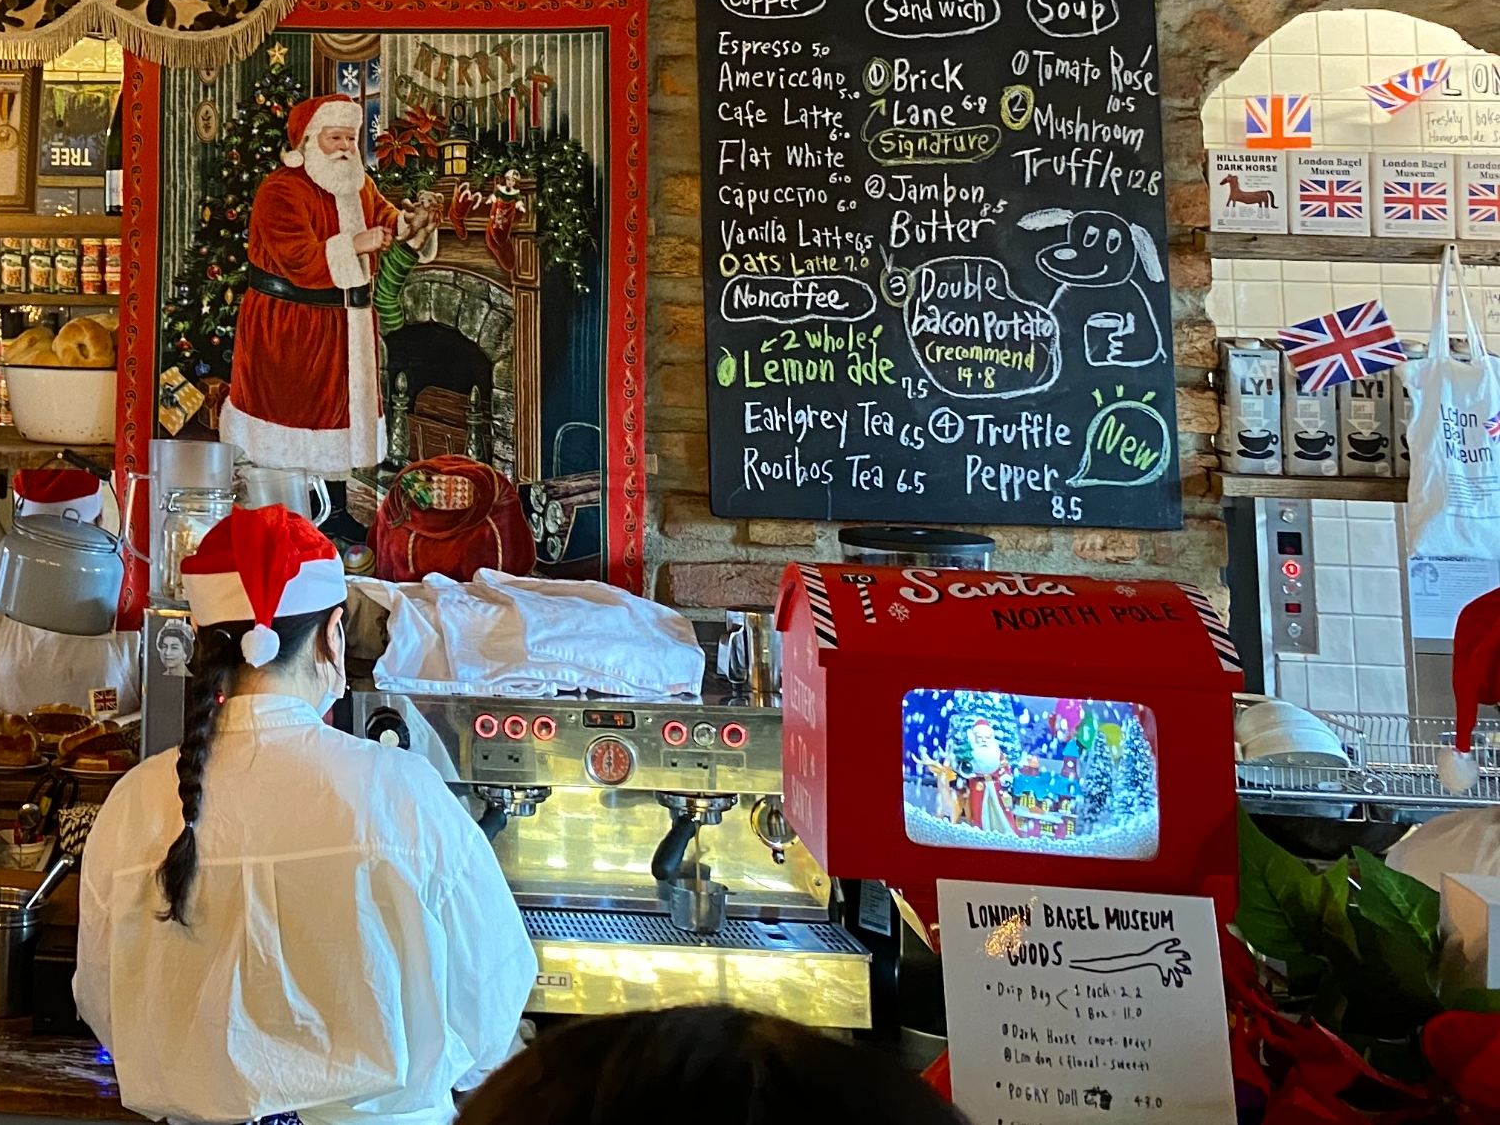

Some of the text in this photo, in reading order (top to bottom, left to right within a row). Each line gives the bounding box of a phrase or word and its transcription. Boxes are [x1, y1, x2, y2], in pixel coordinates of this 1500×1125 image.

[414, 39, 516, 87] MERRY
[718, 31, 801, 65] Espresso
[893, 58, 964, 92] Brick
[1033, 50, 1100, 86] Tomato
[784, 98, 843, 129] Latte
[893, 100, 956, 127] Lane
[1033, 103, 1144, 152] Mushroom
[50, 147, 92, 166] TREE
[718, 138, 772, 175] Flat
[879, 131, 990, 158] Signature
[1216, 154, 1278, 163] HILLSBURRY
[1010, 147, 1122, 196] Truffle
[1217, 164, 1243, 172] DARK
[1298, 157, 1362, 168] London Bagel
[1311, 167, 1350, 176] Museum
[1383, 159, 1447, 170] London Bagel
[1395, 169, 1435, 178] Museum
[888, 173, 985, 207] Jambon
[721, 216, 786, 252] Vanilla
[799, 219, 853, 249] Latte
[890, 208, 996, 249] Butter
[719, 252, 781, 277] Oats
[790, 252, 841, 276] Latte
[921, 262, 1006, 303] Double
[912, 297, 978, 337] bacon
[744, 350, 834, 388] Lemon
[745, 397, 847, 449] Earlgrey
[857, 401, 894, 436] Tea
[967, 411, 1072, 451] Truffle
[1096, 415, 1159, 471] New
[744, 446, 833, 491] Rooibos
[846, 455, 883, 490] Tea
[966, 454, 1059, 502] Pepper
[900, 568, 1075, 603] Santa
[992, 603, 1183, 631] NORTH POLE
[967, 902, 1174, 931] LONDON BAGEL MUSEUM
[1008, 941, 1063, 967] GOODS
